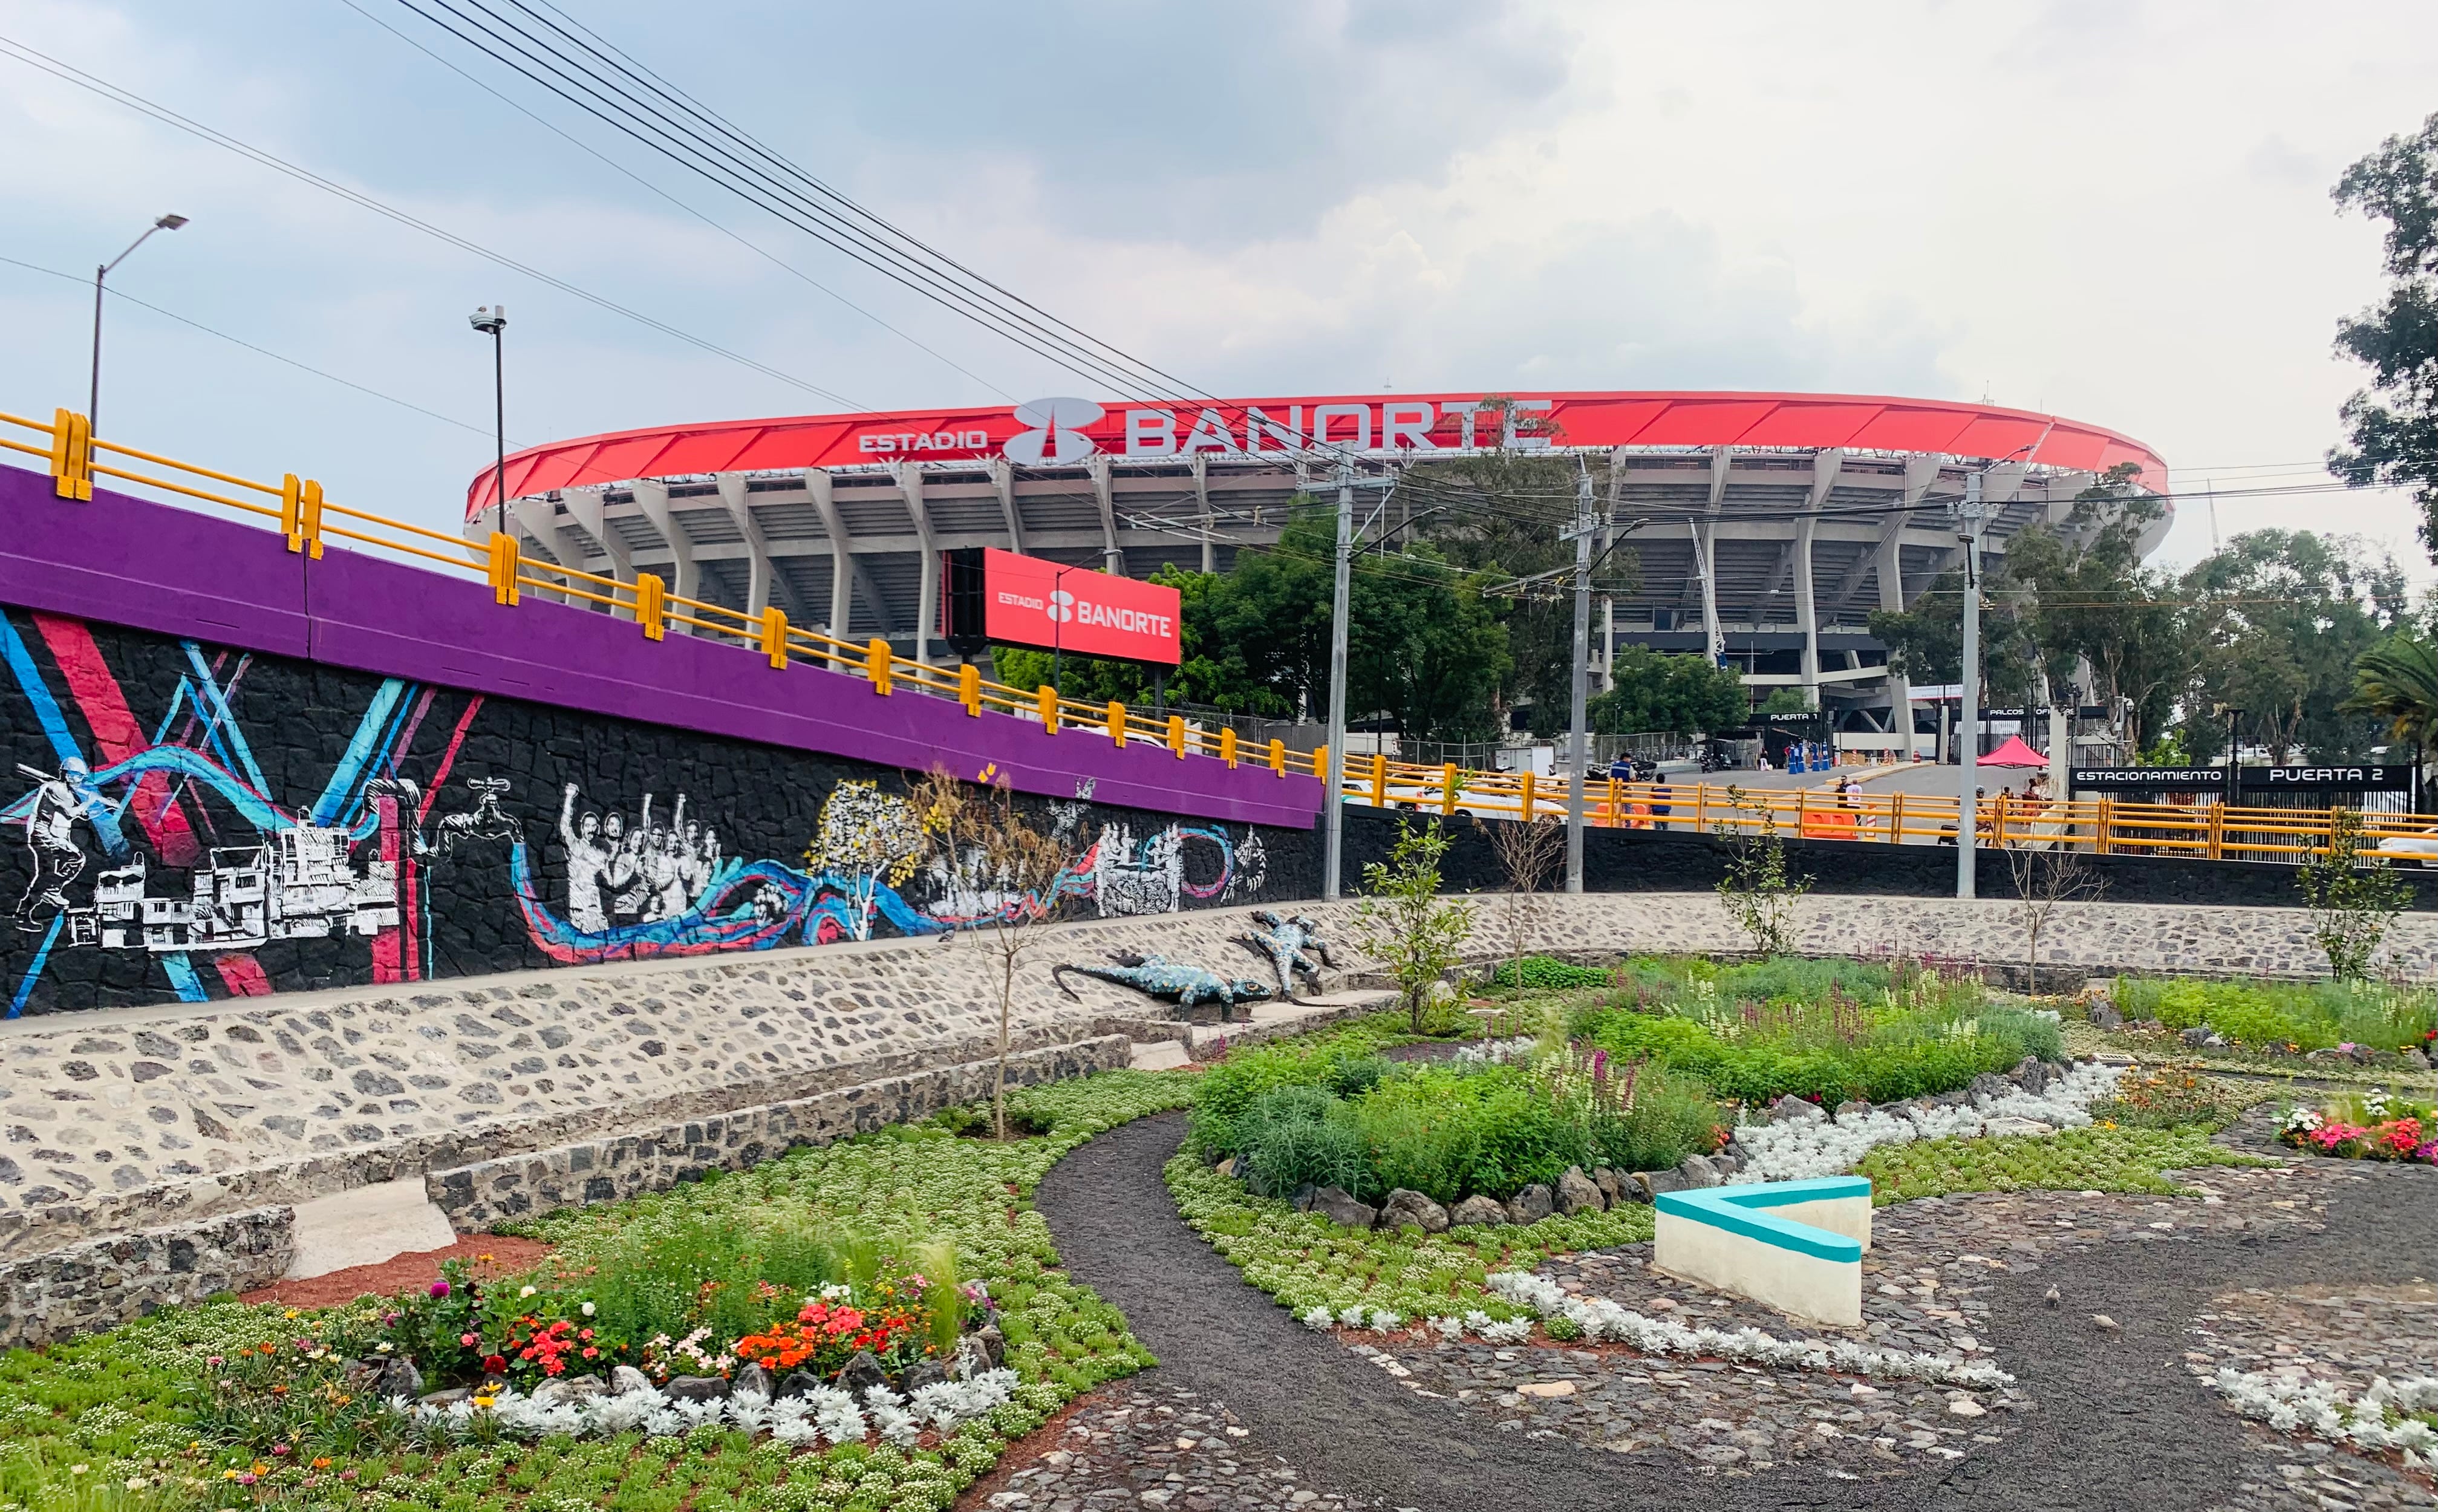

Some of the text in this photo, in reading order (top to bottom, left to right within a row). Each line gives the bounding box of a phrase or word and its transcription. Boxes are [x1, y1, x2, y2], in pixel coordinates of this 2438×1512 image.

[859, 400, 1553, 457] ESTADIO BANORTE
[998, 591, 1172, 638] ESTADIO BANORTE
[2076, 771, 2222, 781] ESTACIONAMIENTO
[2270, 769, 2383, 781] PUERTA 2
